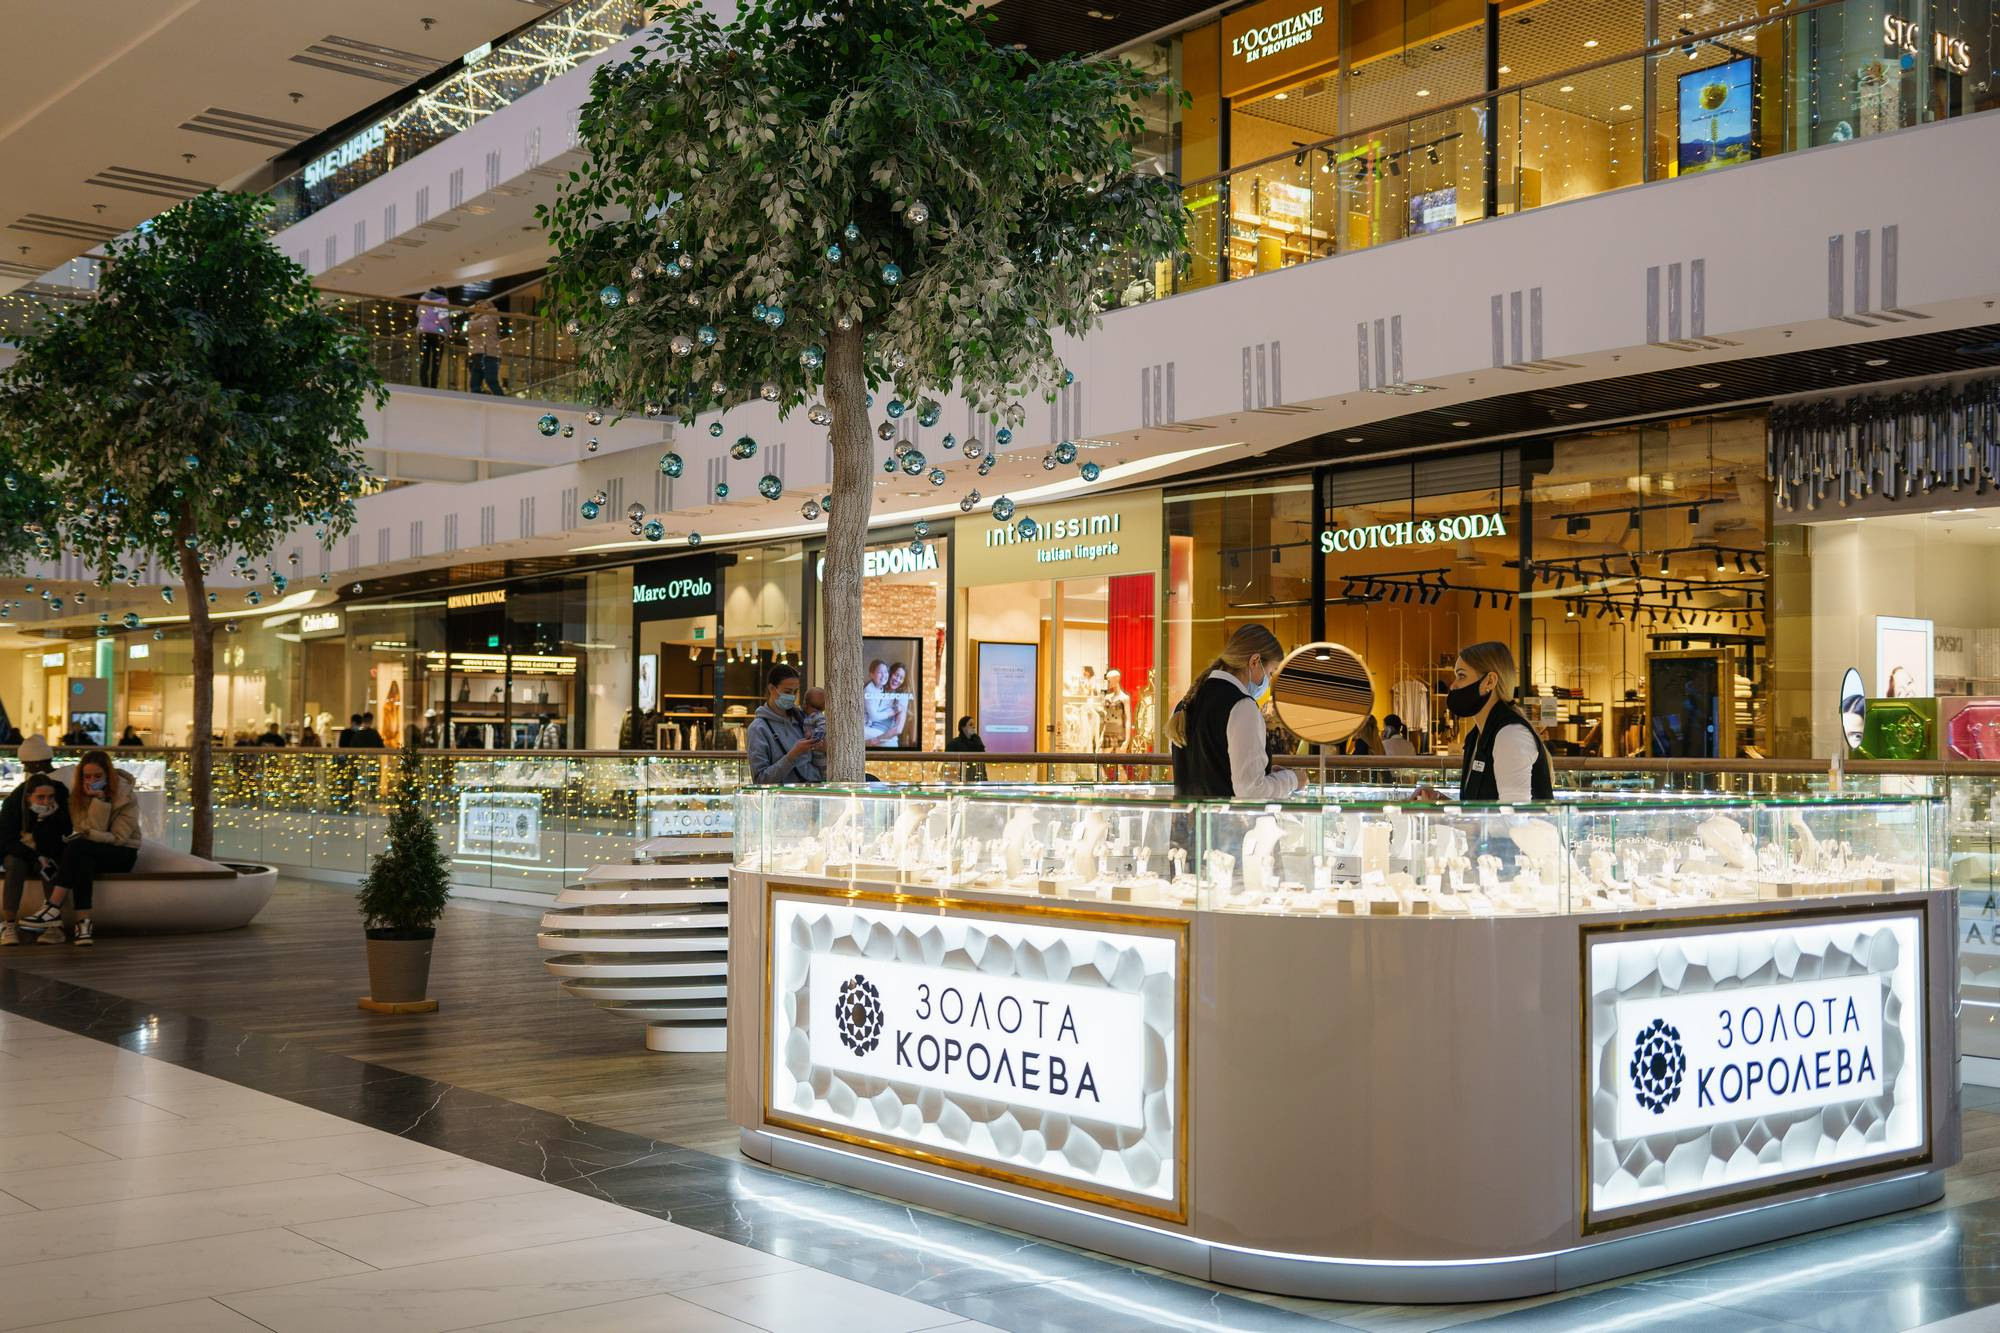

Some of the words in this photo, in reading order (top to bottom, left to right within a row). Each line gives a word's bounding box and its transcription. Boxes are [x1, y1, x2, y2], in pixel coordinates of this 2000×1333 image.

[1232, 6, 1324, 56] L'OCCITANE
[1246, 49, 1260, 63] EN
[1261, 29, 1313, 57] PROVENCE
[1037, 547, 1072, 562] Italian
[1074, 541, 1119, 560] lingerie
[633, 584, 667, 603] Marc
[668, 577, 712, 599] O'Polo
[916, 983, 1079, 1044] ЗОЛОТА
[1717, 996, 1860, 1049] ЗОЛОТА
[896, 1030, 1100, 1103] КОРОЛЕВА
[1697, 1045, 1876, 1108] КОРОЛЕВА
